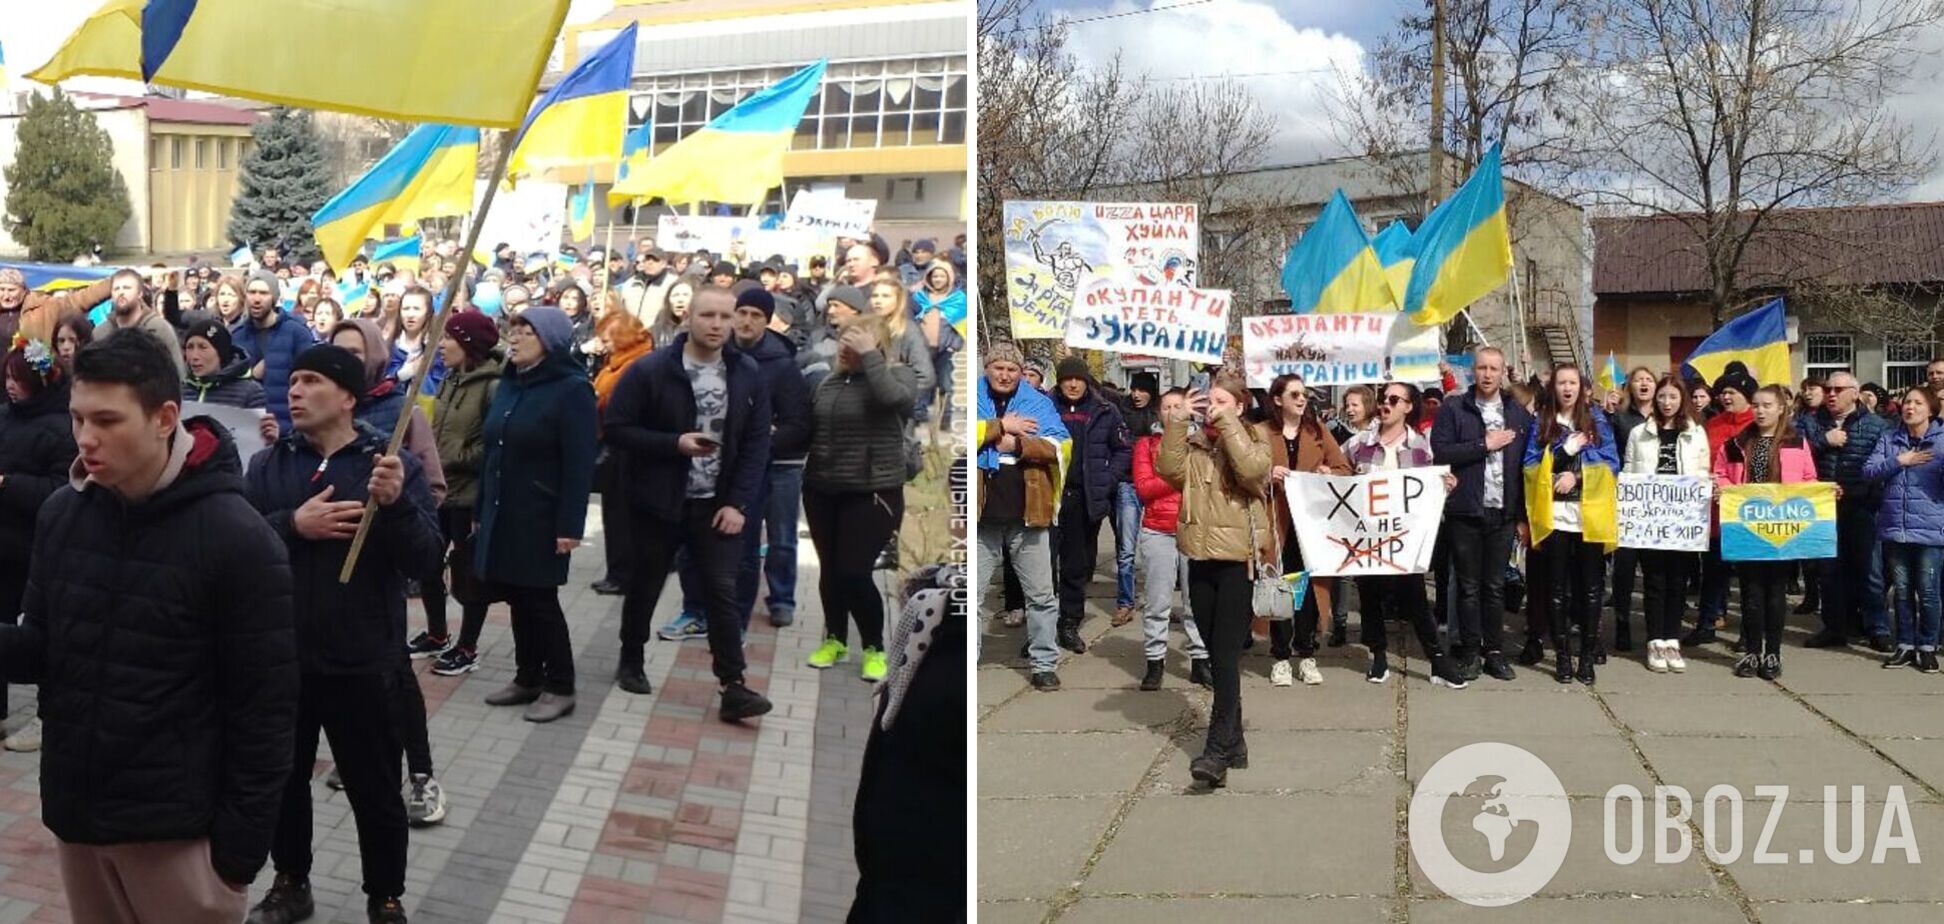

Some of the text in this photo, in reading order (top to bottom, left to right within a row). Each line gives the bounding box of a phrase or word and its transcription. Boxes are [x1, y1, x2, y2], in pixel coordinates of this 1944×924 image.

[1149, 205, 1194, 223] ЦАРЯ
[1086, 287, 1225, 318] ОКУПАНТИ
[1250, 315, 1383, 337] ОКУПАНТИ
[1327, 475, 1424, 520] ХЕР
[1743, 504, 1811, 520] FUKING
[1354, 516, 1403, 533] А НЕ
[1757, 522, 1800, 536] PUTIN
[1340, 536, 1405, 568] ХНР
